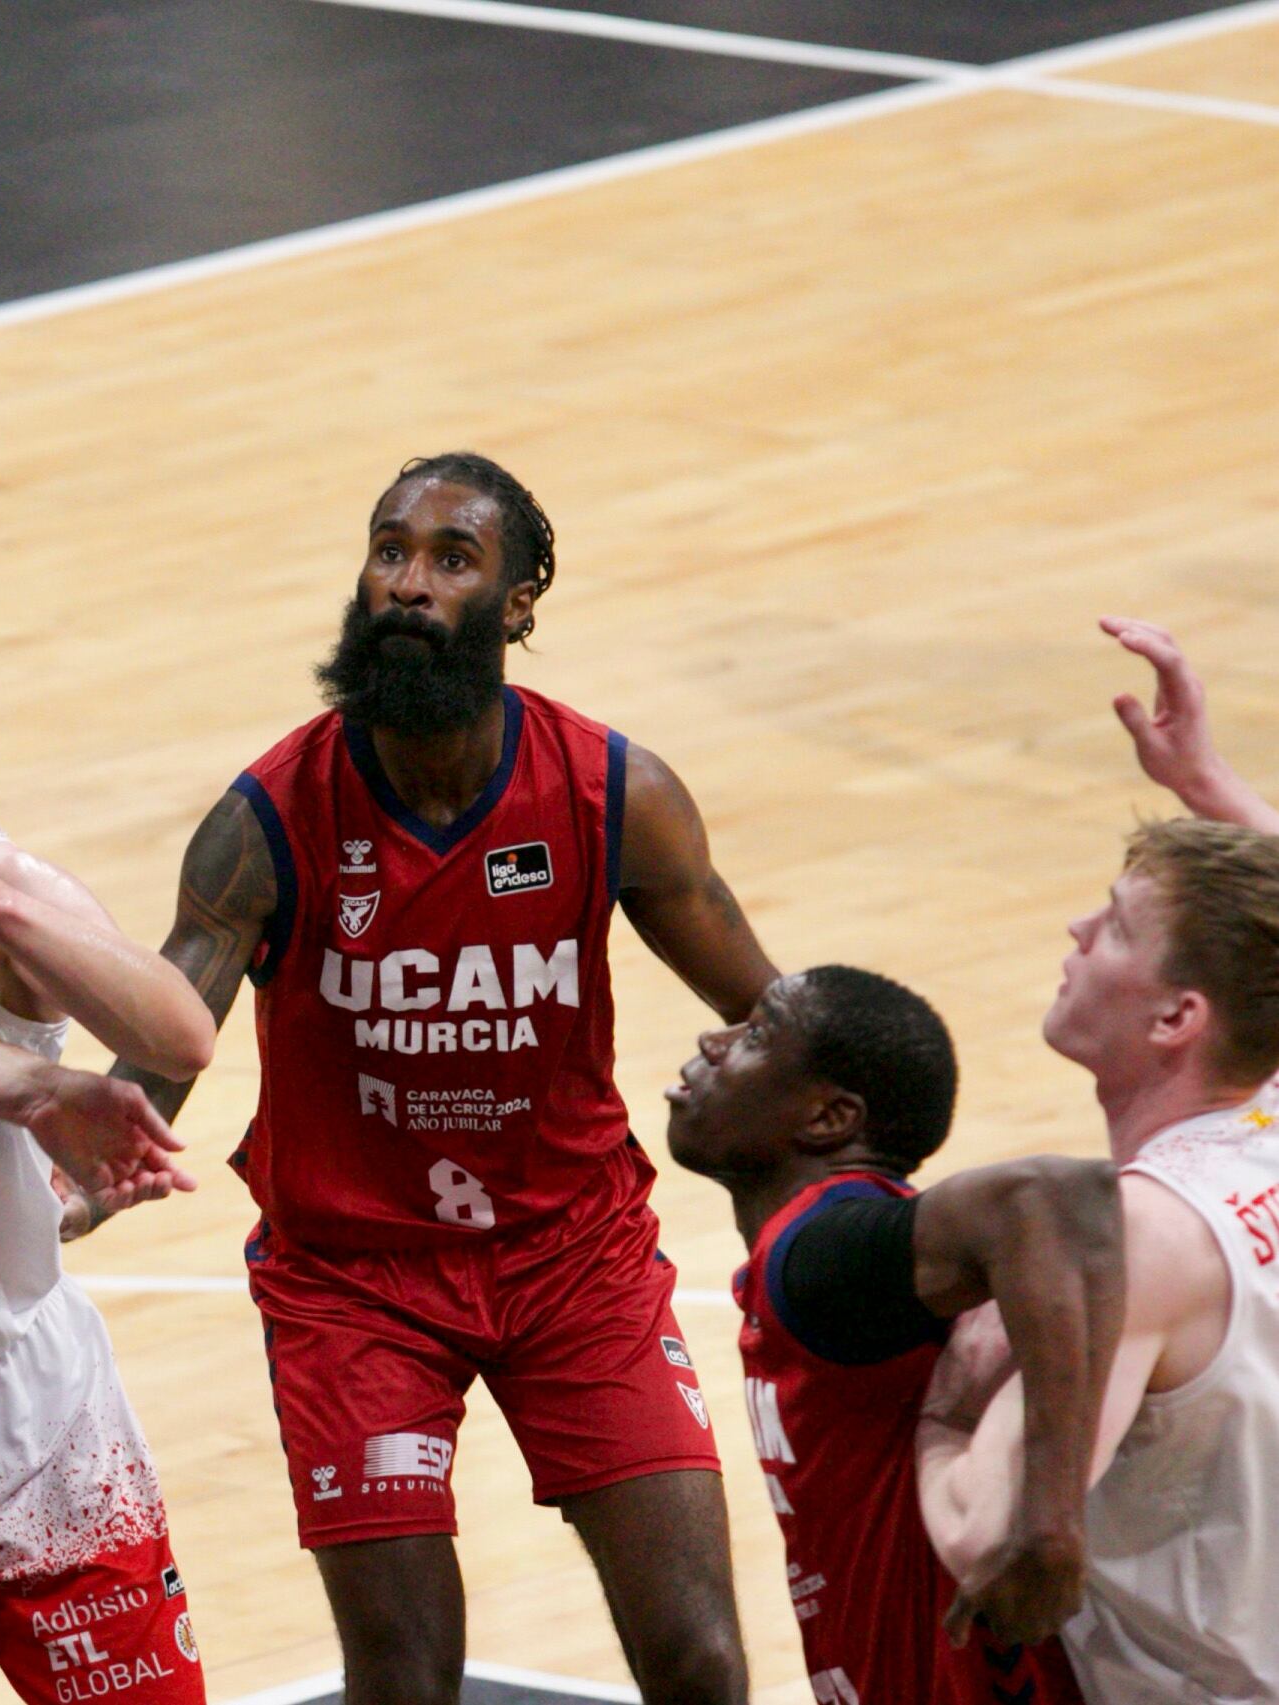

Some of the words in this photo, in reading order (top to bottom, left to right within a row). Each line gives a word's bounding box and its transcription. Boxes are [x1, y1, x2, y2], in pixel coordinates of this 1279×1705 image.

[492, 863, 517, 878] liga
[494, 870, 548, 889] endesa
[319, 938, 580, 1012] UCAM
[354, 1016, 539, 1055] MURCIA
[406, 1088, 496, 1101] CARAVACA
[407, 1103, 426, 1115] DE
[429, 1104, 448, 1115] LA
[451, 1103, 493, 1117] CRUZ
[496, 1097, 532, 1116] 2024
[407, 1116, 439, 1131] AÑO
[442, 1117, 502, 1132] JUBILAR
[428, 1157, 496, 1231] 8
[391, 1432, 452, 1481] ESP
[32, 1584, 149, 1638] Adbisio
[43, 1630, 110, 1672] ETL
[56, 1652, 175, 1704] GLOBAL
